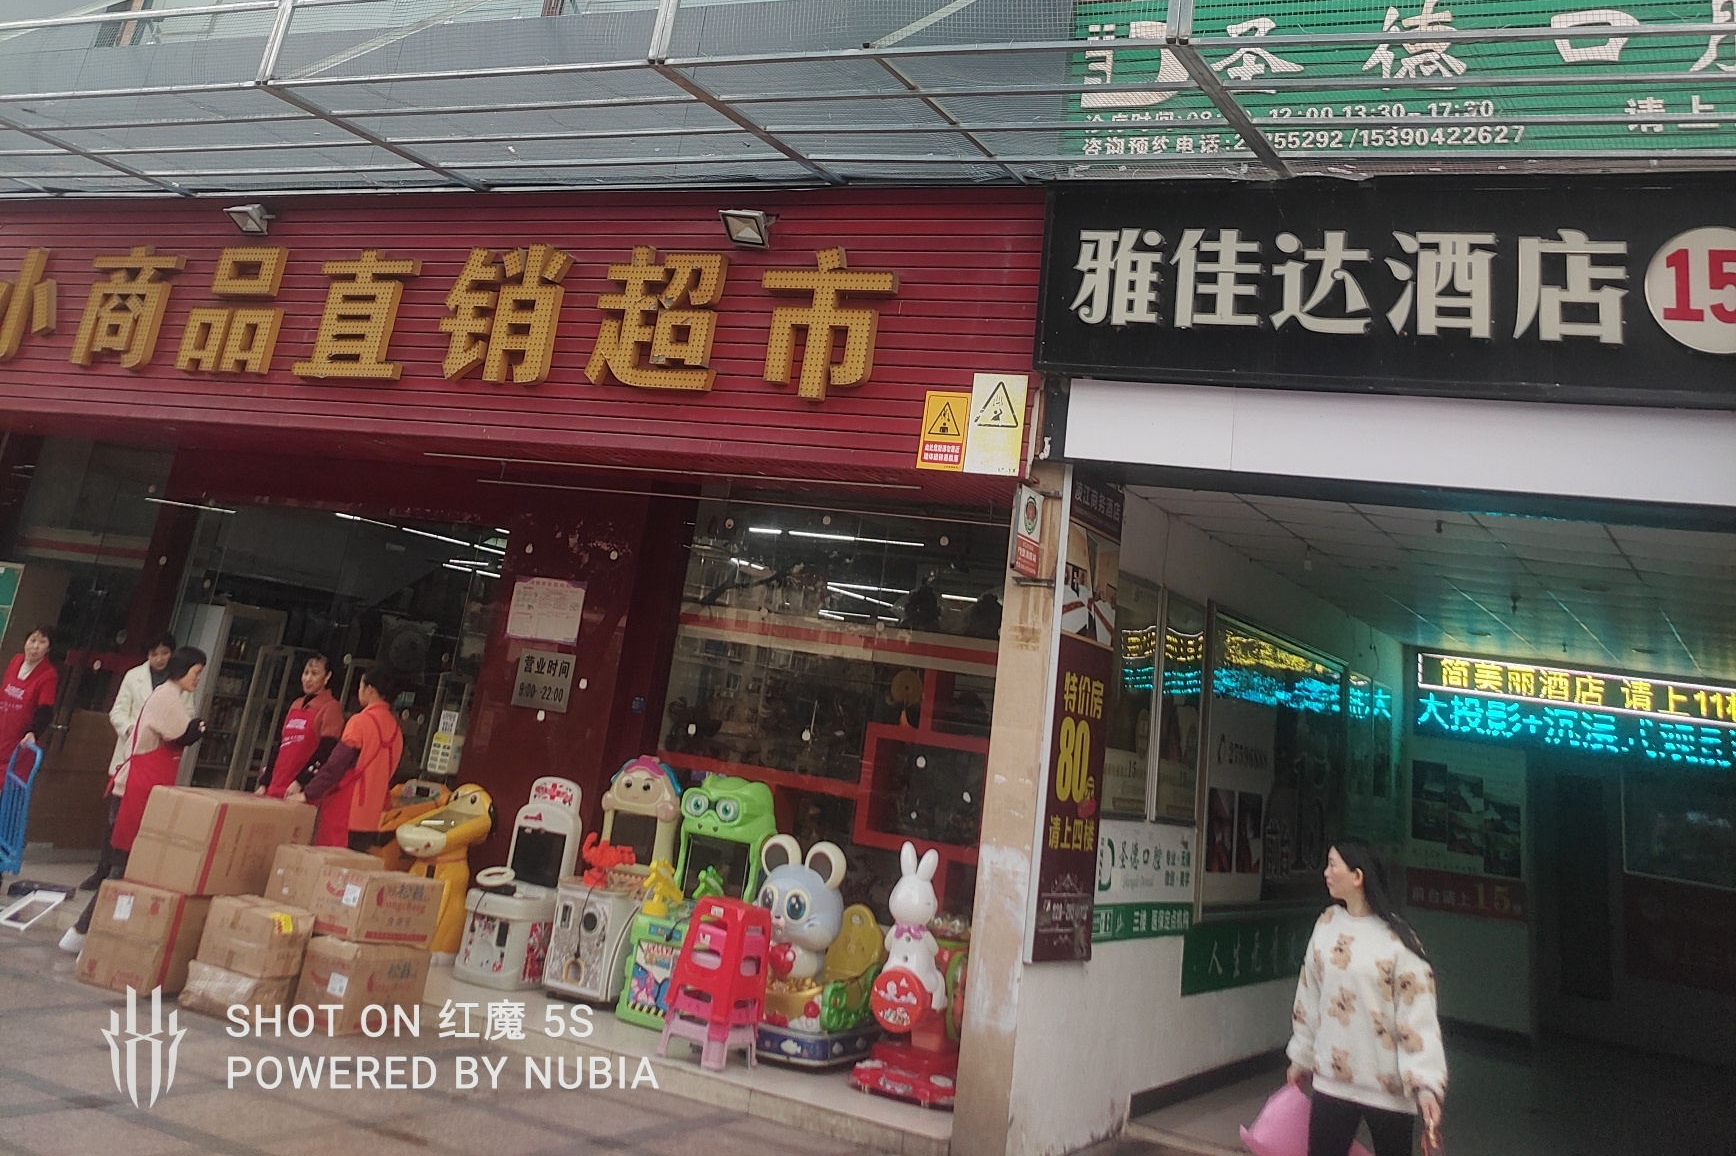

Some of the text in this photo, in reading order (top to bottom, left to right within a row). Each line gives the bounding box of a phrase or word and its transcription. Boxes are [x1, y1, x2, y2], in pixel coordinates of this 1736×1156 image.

[1069, 227, 1629, 345] 雅佳达酒店
[0, 244, 898, 402] 小商品直销超市
[523, 654, 570, 679] 营业时间
[1440, 658, 1605, 706] 简美丽酒店
[1063, 670, 1105, 720] 特价房
[1056, 715, 1090, 803] 80
[1048, 814, 1095, 852] 请上四楼
